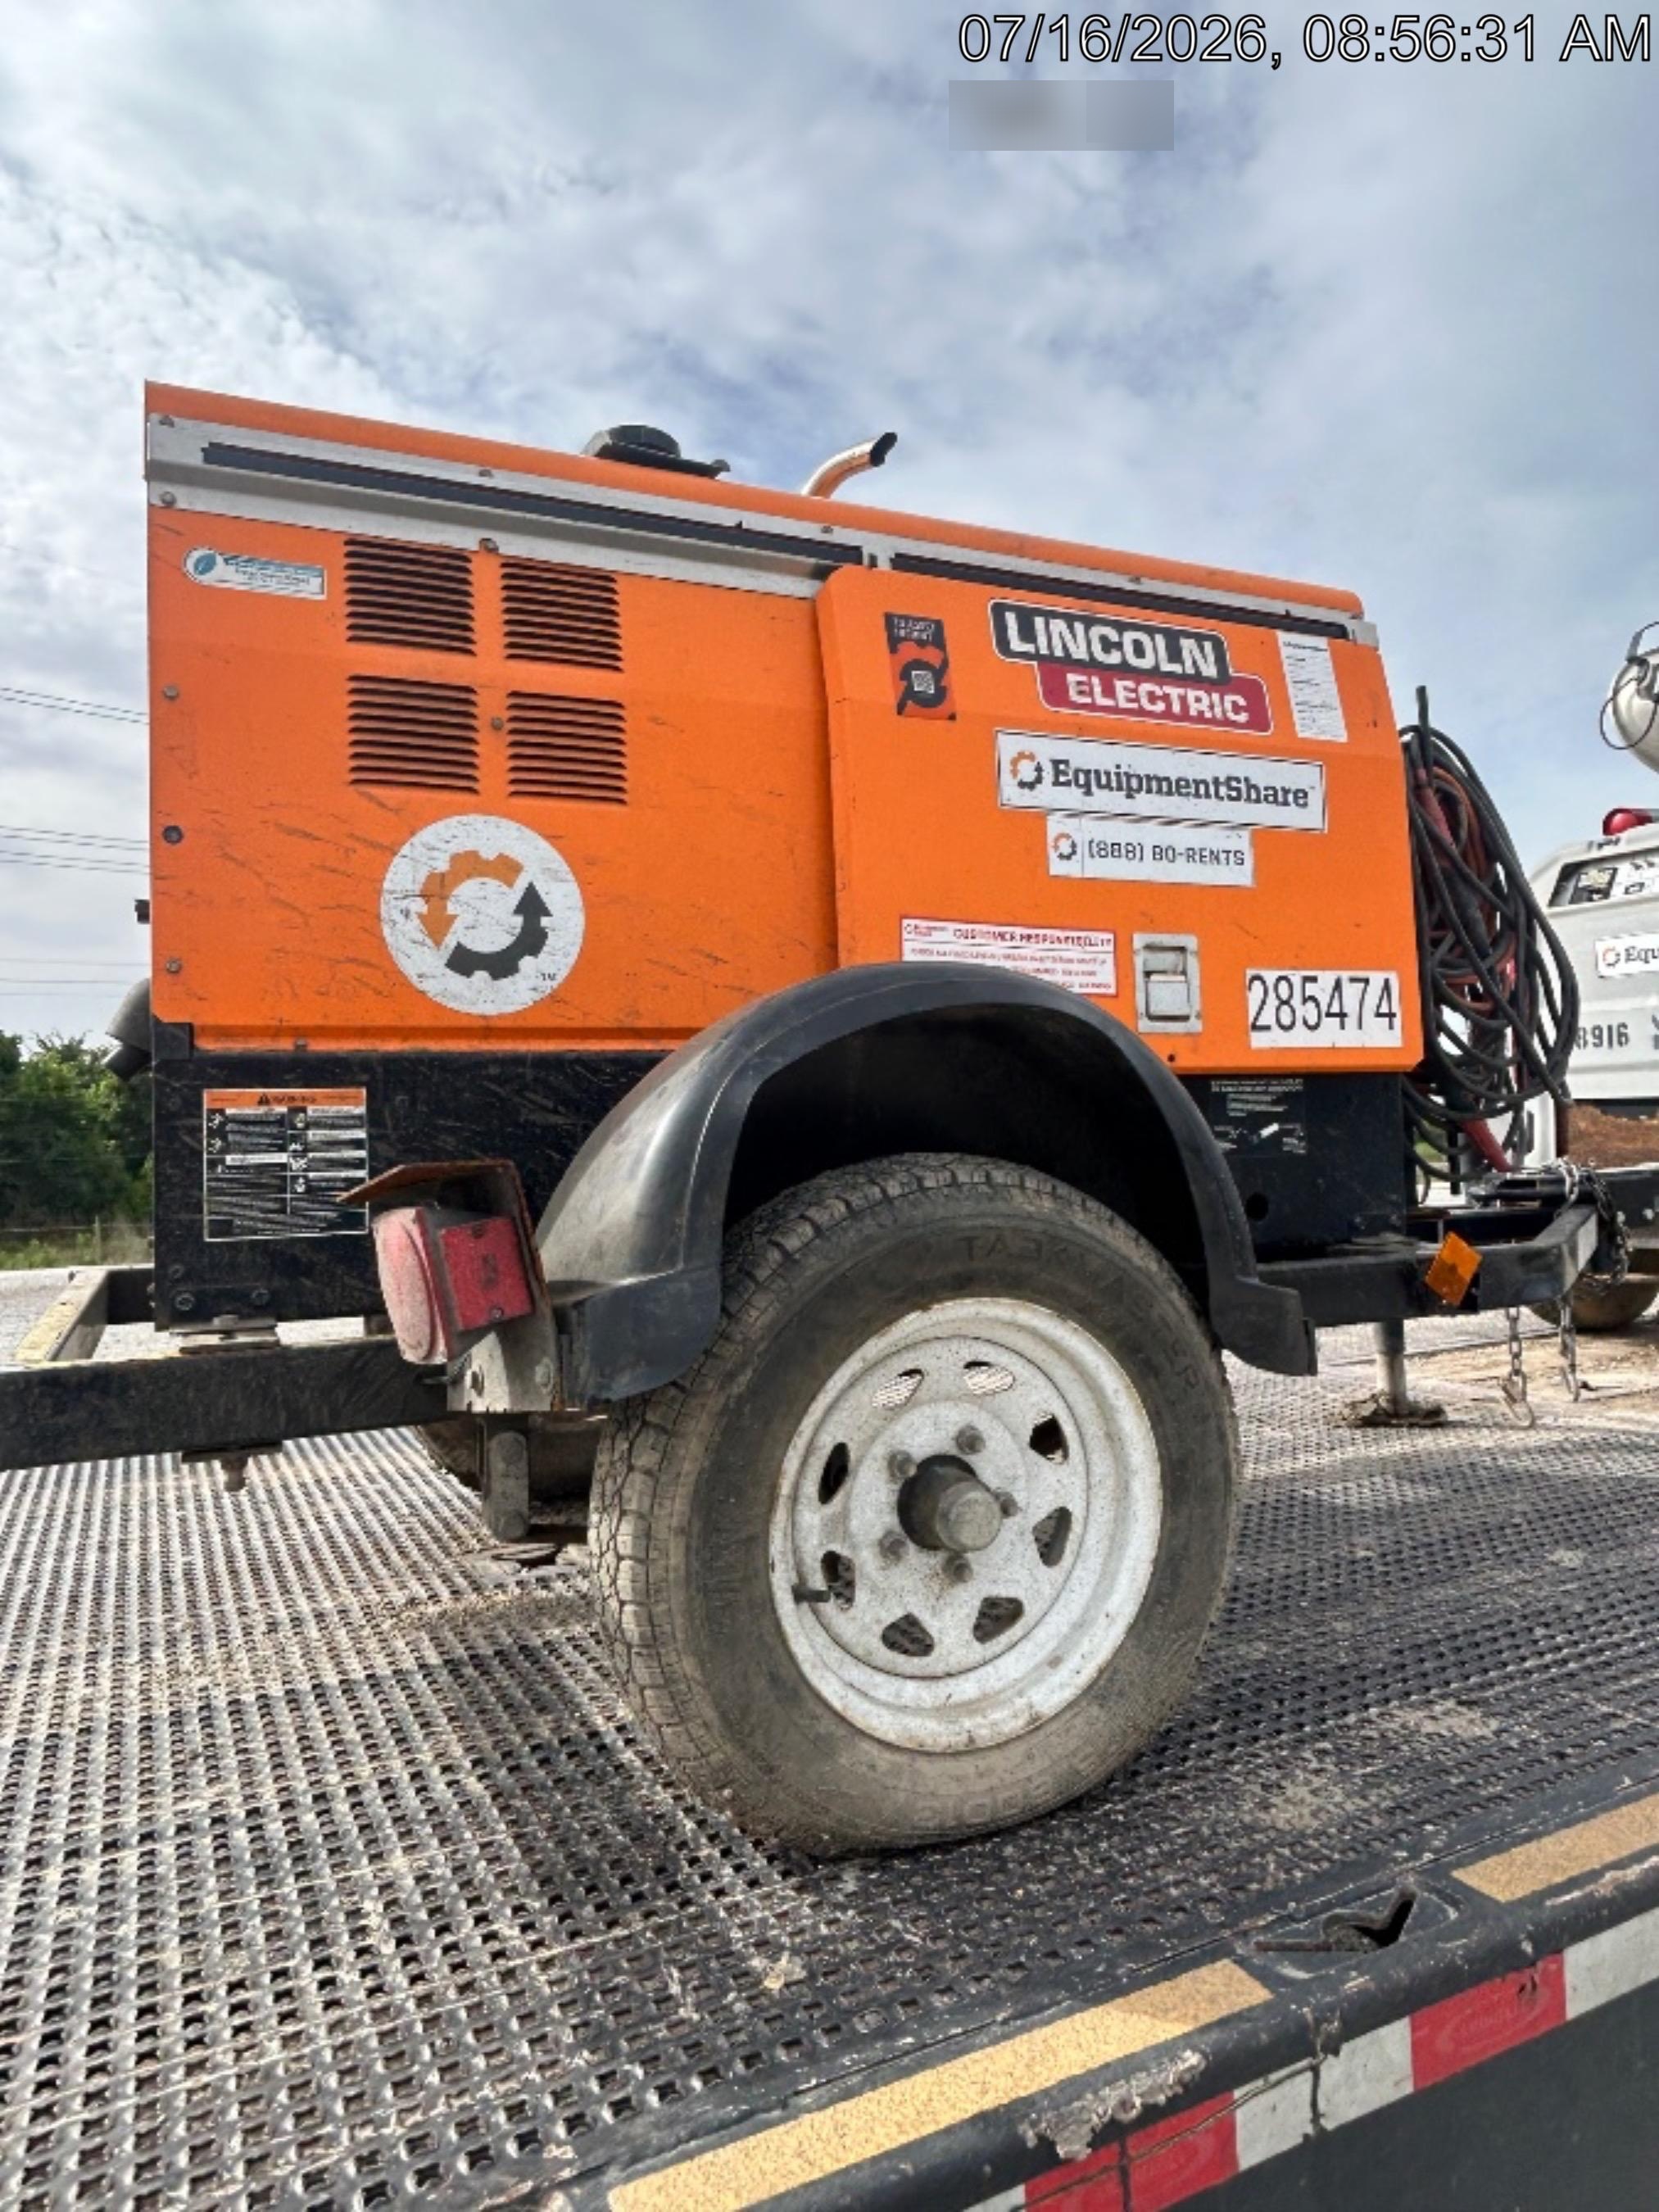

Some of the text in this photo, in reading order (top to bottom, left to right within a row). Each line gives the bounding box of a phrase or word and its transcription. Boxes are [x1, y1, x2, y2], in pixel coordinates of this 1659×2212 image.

[1004, 611, 1219, 679] LINCOLN
[1066, 673, 1249, 723] ELECTRIC
[1088, 839, 1145, 862] (888)
[1248, 973, 1398, 1032] 285474
